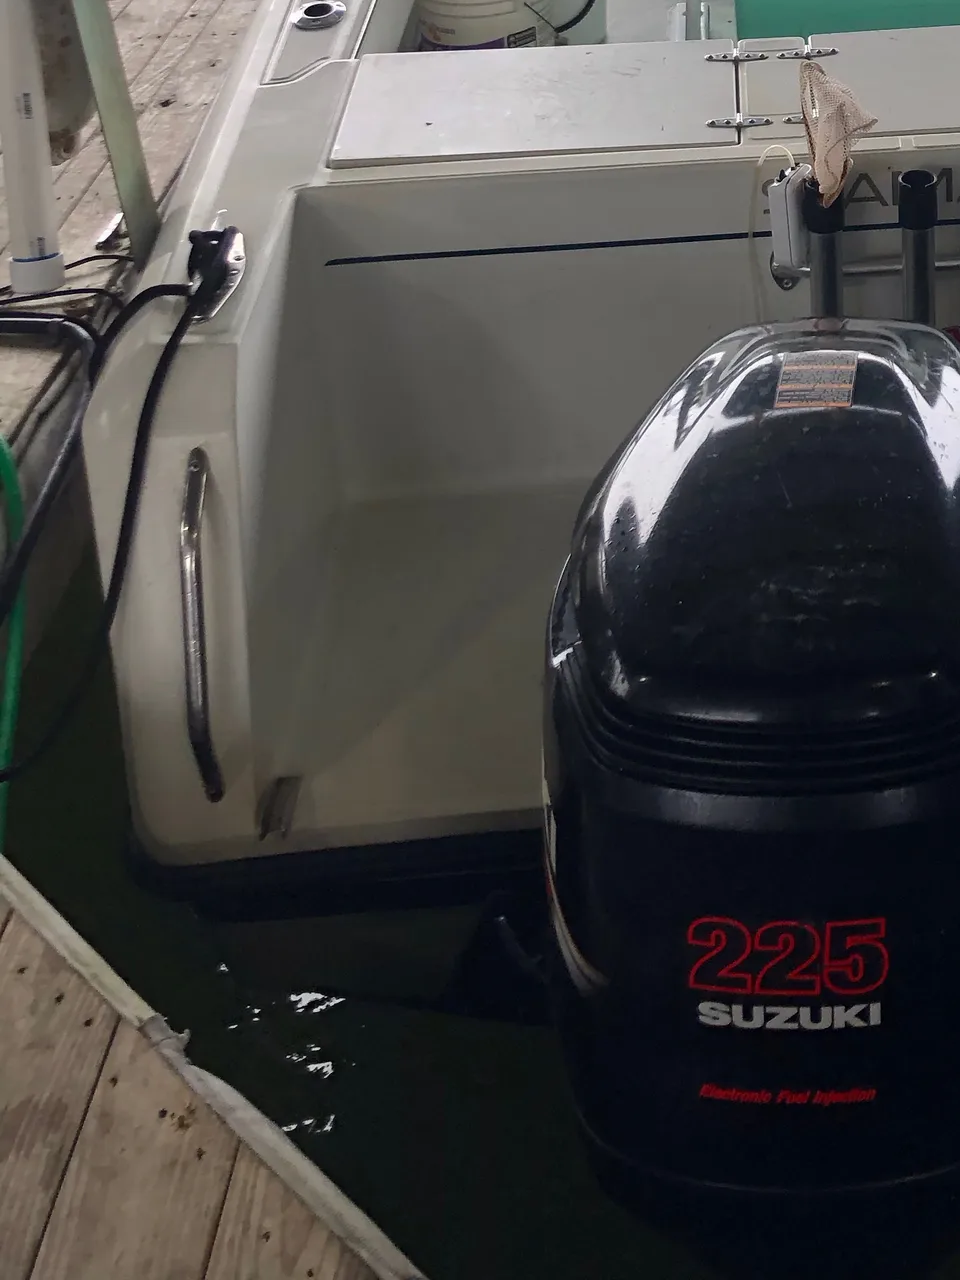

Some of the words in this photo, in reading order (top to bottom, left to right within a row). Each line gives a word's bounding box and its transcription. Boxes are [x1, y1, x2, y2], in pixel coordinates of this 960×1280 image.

[687, 916, 889, 996] 225
[698, 1001, 882, 1030] SUZUKI
[699, 1082, 772, 1104] Electronic
[775, 1088, 811, 1105] Fuel
[811, 1086, 878, 1107] Injection
